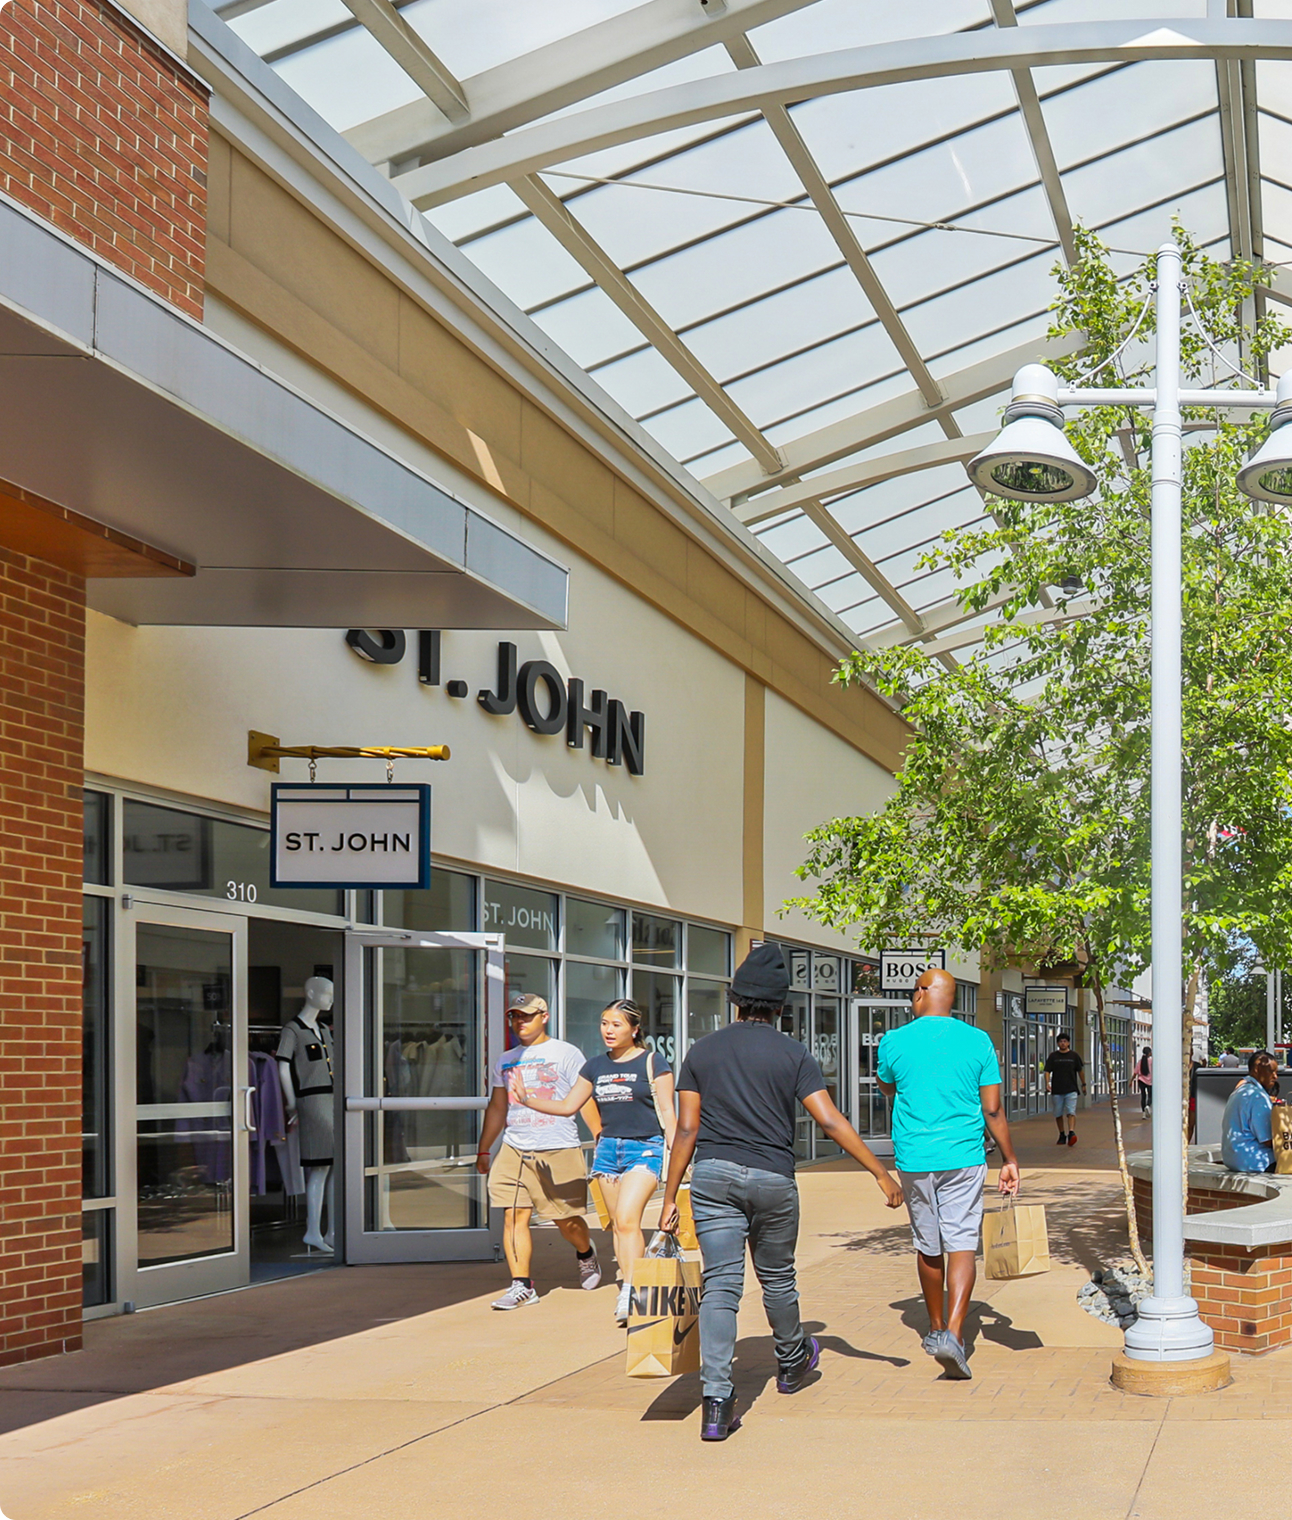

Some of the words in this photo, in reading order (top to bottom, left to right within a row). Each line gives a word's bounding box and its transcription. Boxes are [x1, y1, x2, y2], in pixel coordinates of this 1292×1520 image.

[477, 641, 645, 776] JOHN
[285, 832, 324, 851] ST.
[331, 832, 411, 852] JOHN
[226, 880, 258, 903] 310
[507, 905, 554, 932] JOHN
[645, 1035, 675, 1063] OSS
[862, 1033, 885, 1046] BO
[629, 1286, 685, 1317] NIKE
